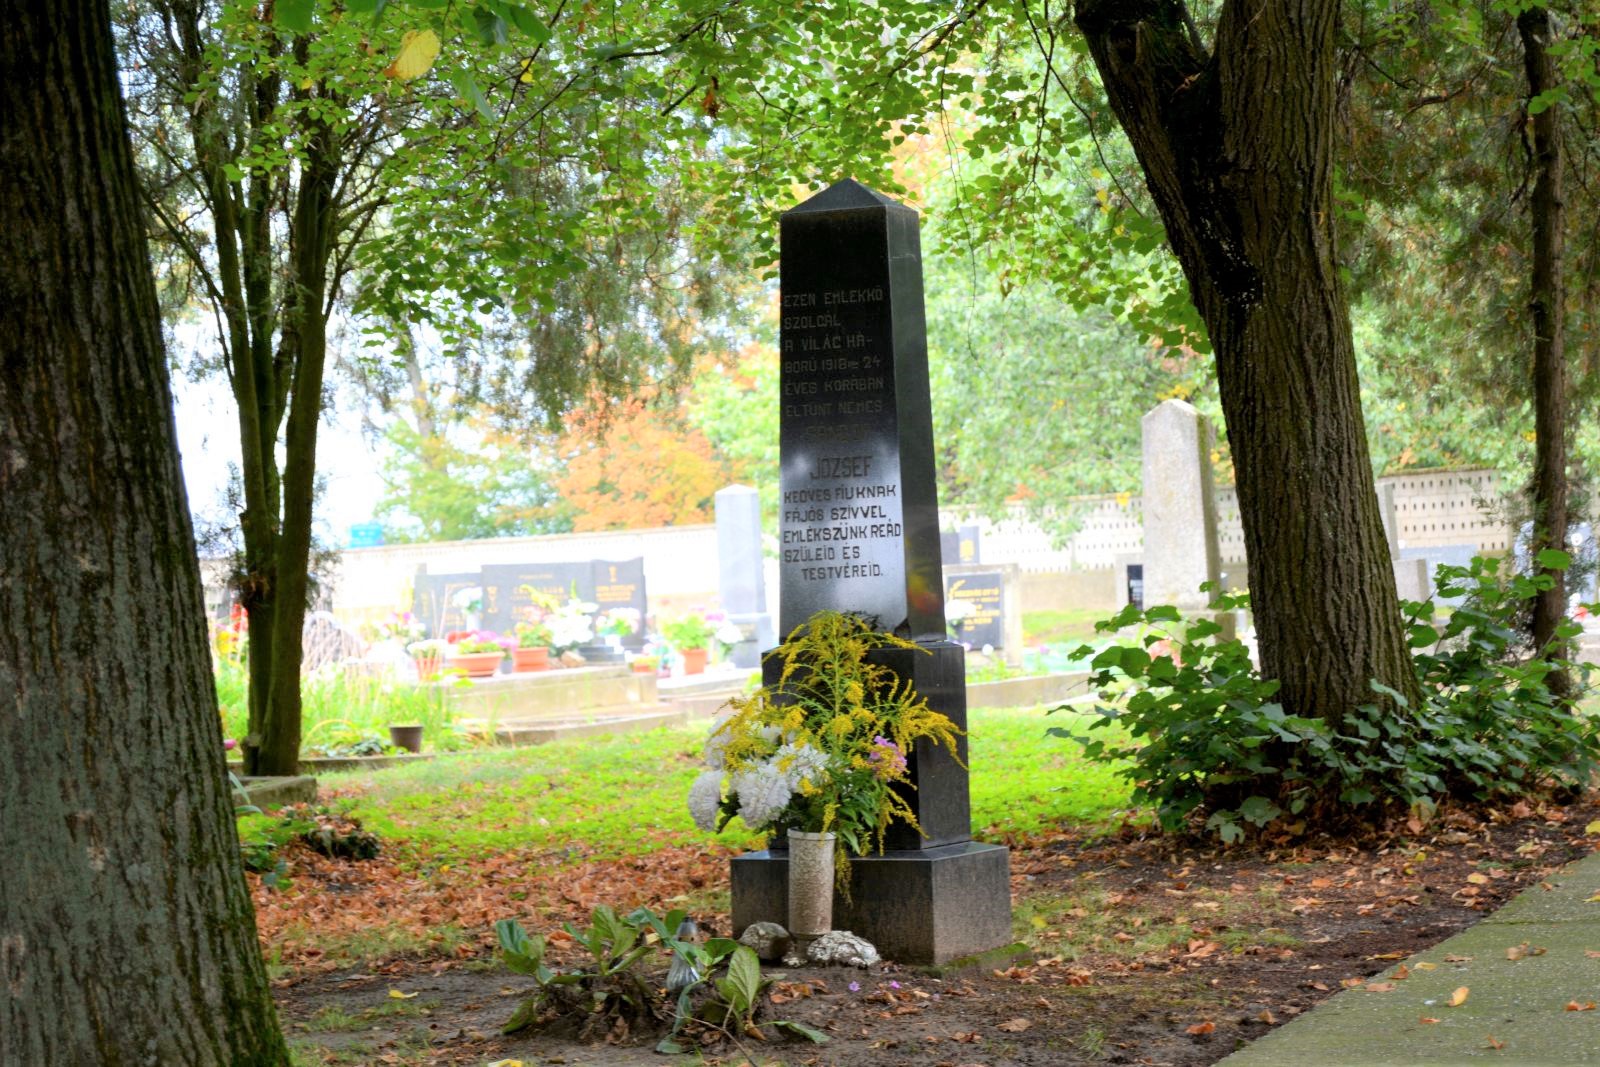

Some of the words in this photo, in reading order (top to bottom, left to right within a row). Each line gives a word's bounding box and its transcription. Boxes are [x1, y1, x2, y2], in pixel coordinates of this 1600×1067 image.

[863, 354, 882, 369] 24
[783, 488, 832, 504] KEDVES
[842, 542, 861, 560] ÉS
